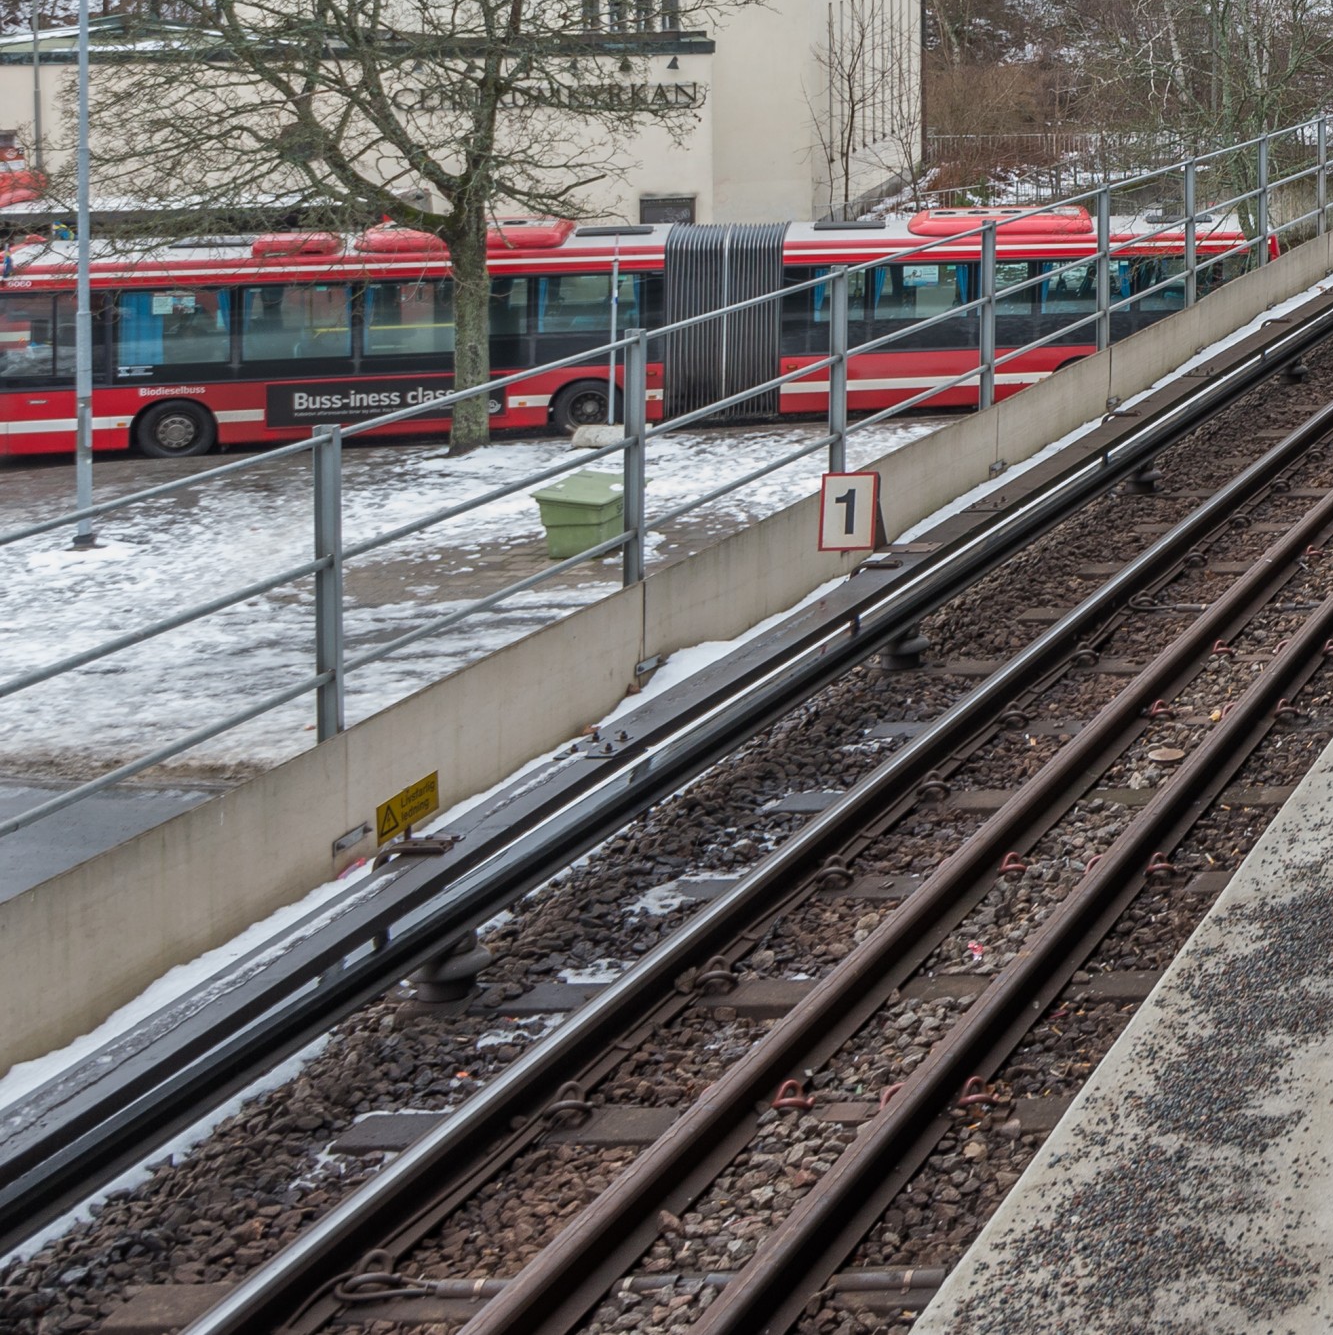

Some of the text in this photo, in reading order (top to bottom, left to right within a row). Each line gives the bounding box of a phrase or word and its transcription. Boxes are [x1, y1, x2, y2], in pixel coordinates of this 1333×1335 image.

[139, 386, 207, 397] Biodieselbuss
[293, 390, 401, 411] Buss-iness
[834, 488, 857, 535] 1
[400, 780, 436, 808] Livsfarlig
[401, 797, 430, 822] ledning
